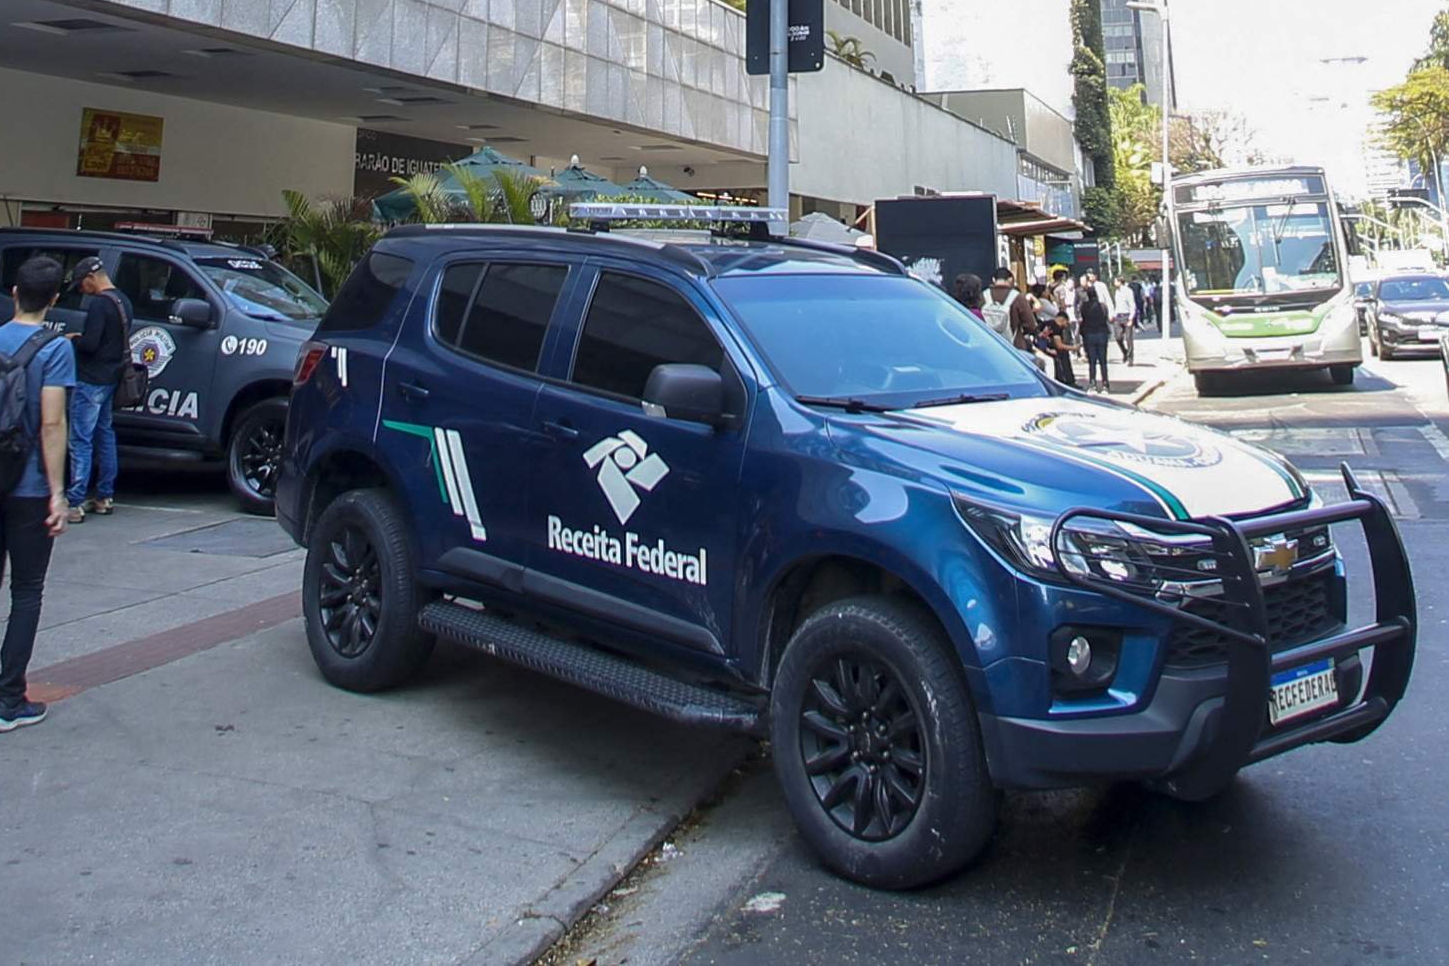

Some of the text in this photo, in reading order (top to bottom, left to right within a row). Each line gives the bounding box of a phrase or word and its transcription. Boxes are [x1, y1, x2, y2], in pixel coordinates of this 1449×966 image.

[391, 157, 405, 174] DE
[238, 337, 267, 356] 190
[547, 514, 708, 586] Receita Federal
